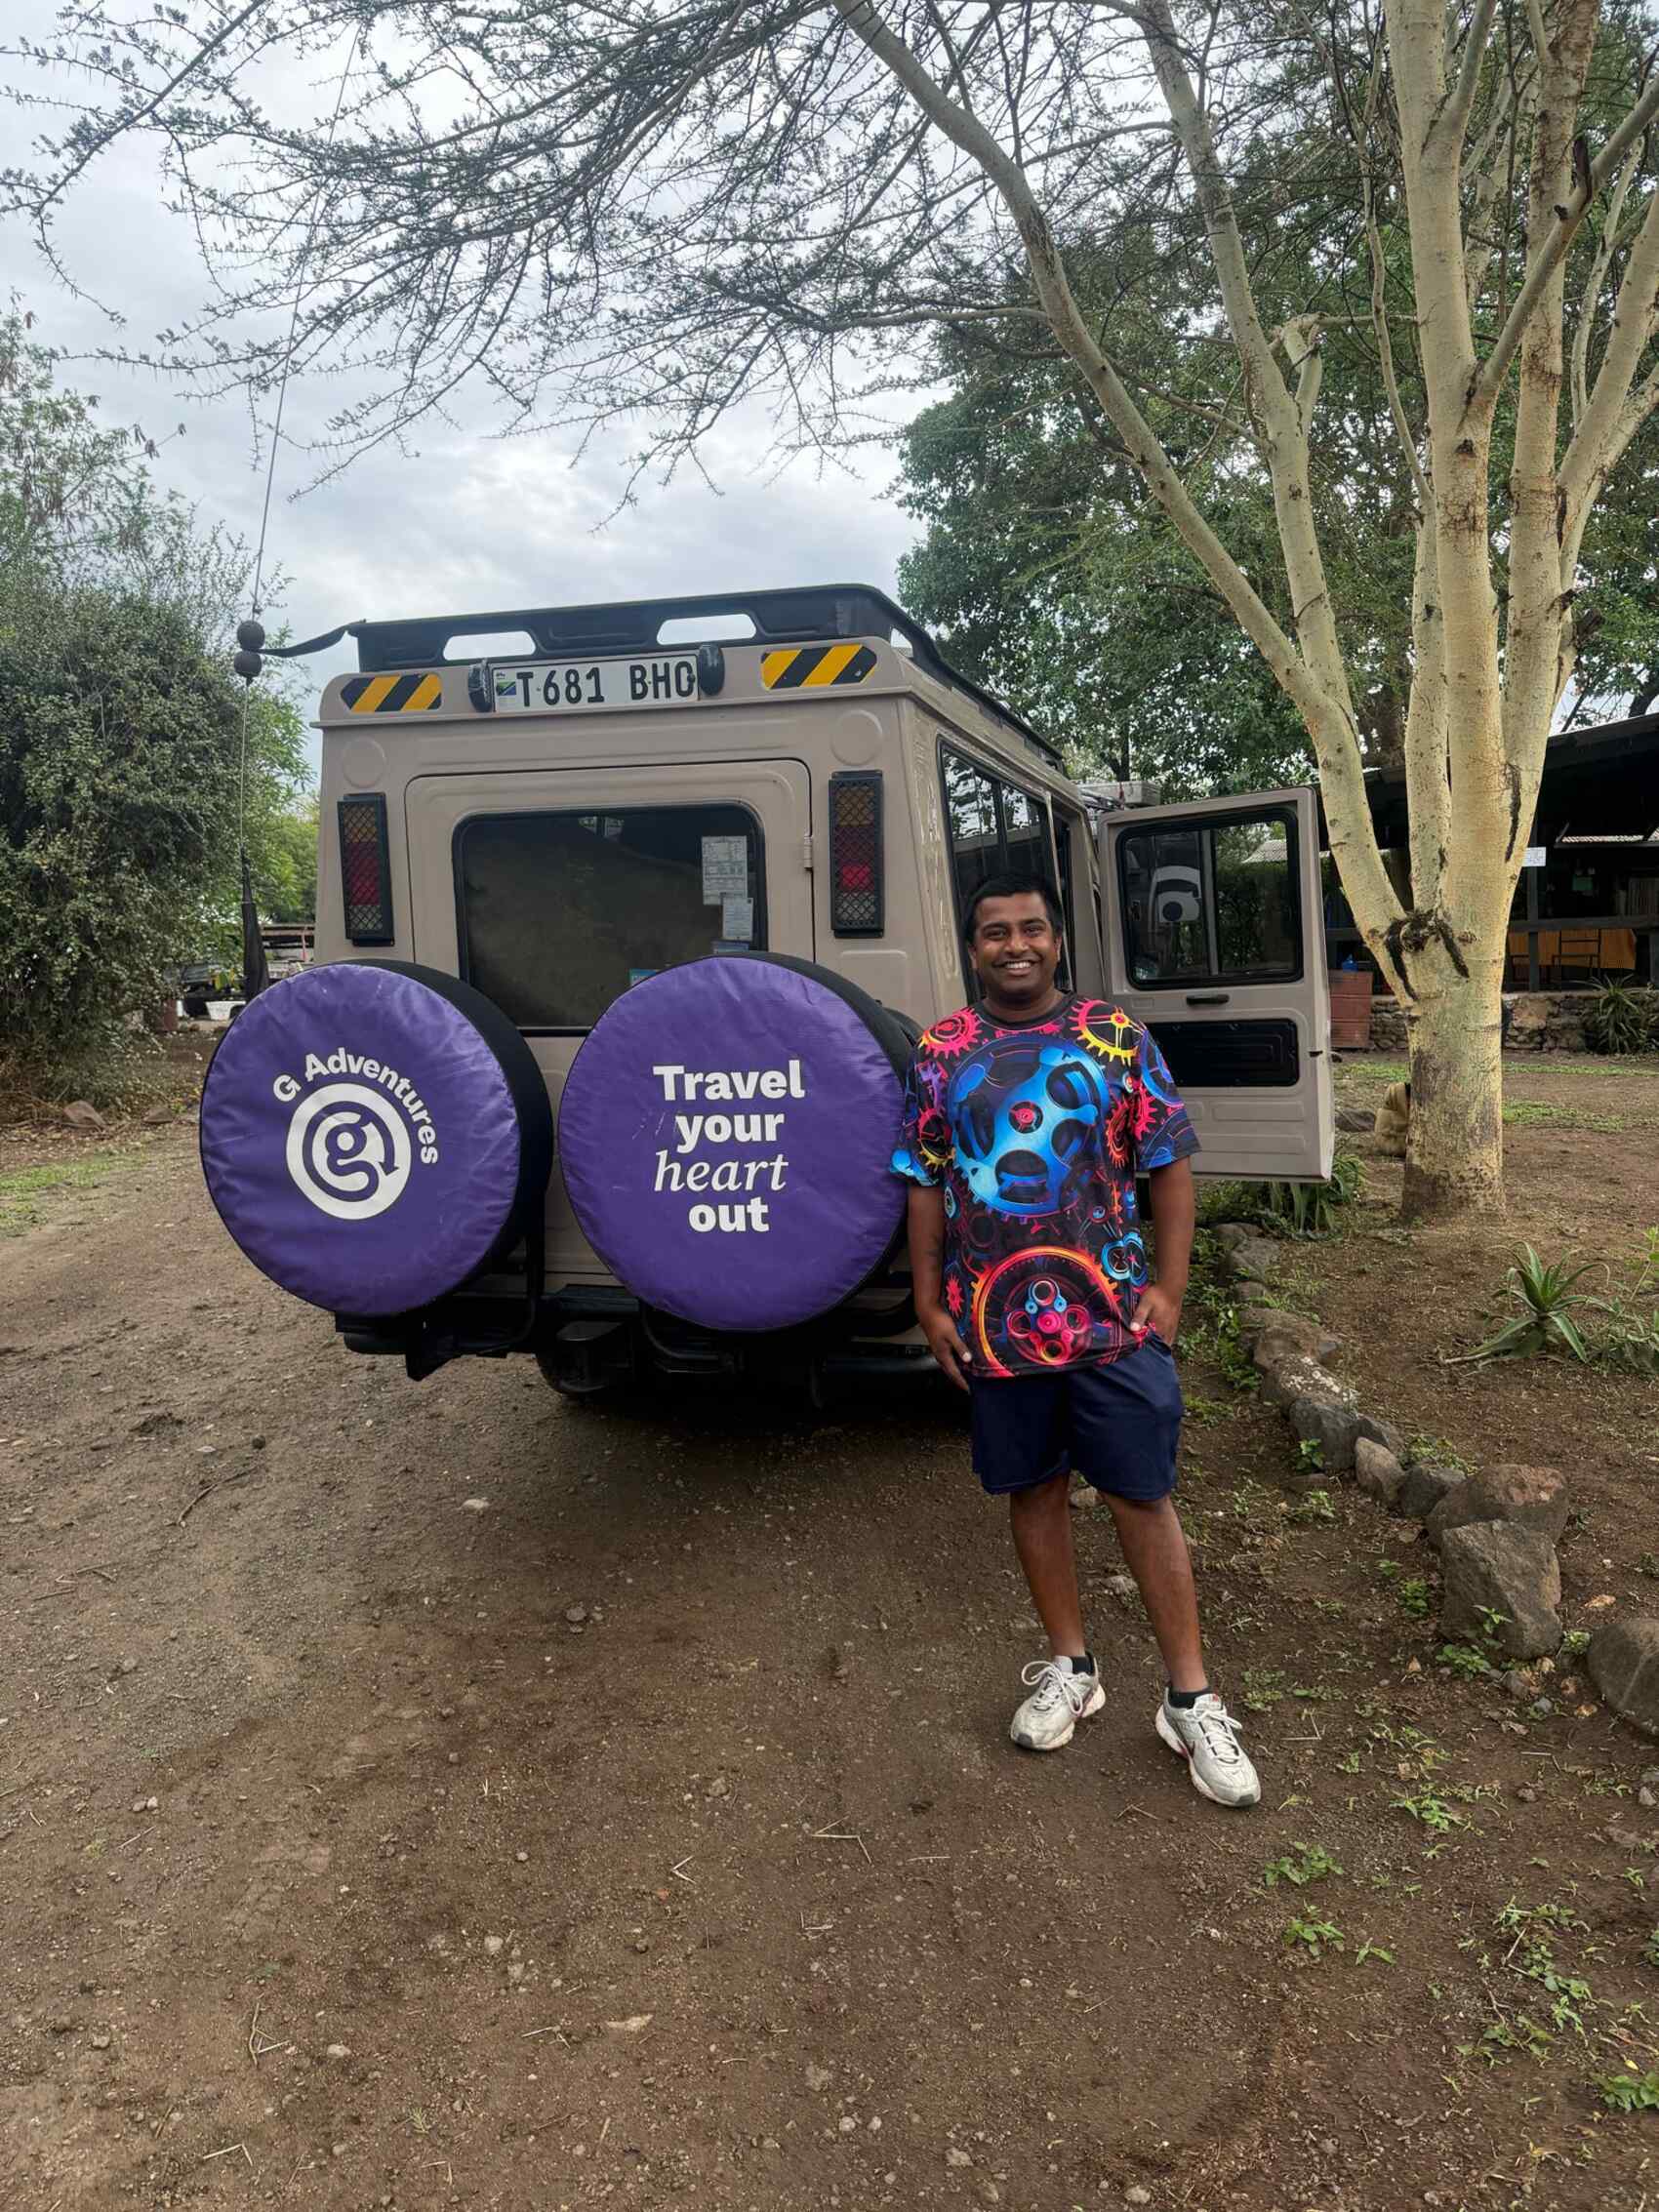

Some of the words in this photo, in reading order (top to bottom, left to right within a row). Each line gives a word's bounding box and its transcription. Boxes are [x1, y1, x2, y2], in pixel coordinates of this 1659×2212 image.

[516, 671, 534, 707] T
[543, 666, 605, 706] 681
[653, 1060, 805, 1101] Travel
[272, 1074, 302, 1102] G
[304, 1047, 438, 1164] Adventures
[675, 1113, 785, 1153] your
[654, 1149, 789, 1191] heart
[688, 1196, 769, 1231] out
